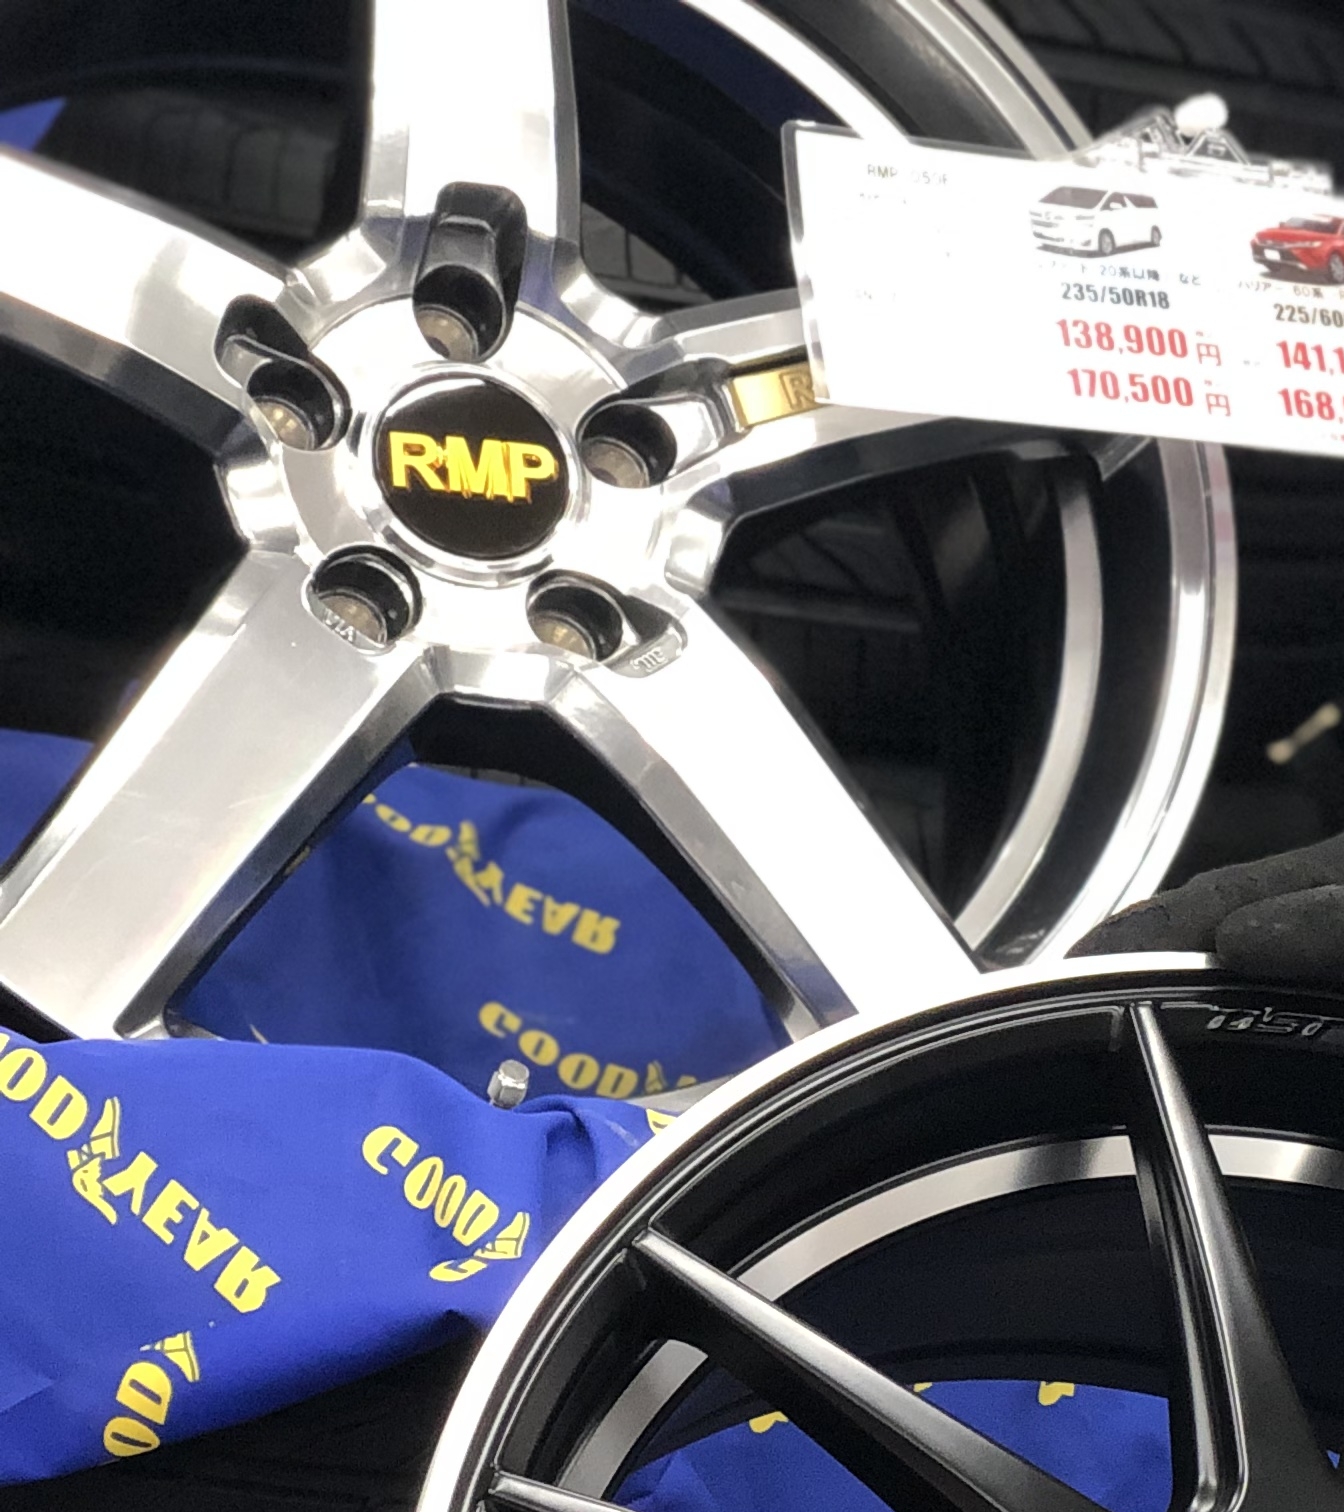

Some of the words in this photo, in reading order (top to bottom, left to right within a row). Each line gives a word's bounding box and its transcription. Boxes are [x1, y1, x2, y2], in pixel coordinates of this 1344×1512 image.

[1060, 281, 1171, 310] 235/50R18
[1055, 318, 1189, 359] 138,900
[1066, 366, 1194, 408] 170,500
[388, 430, 559, 504] RMP
